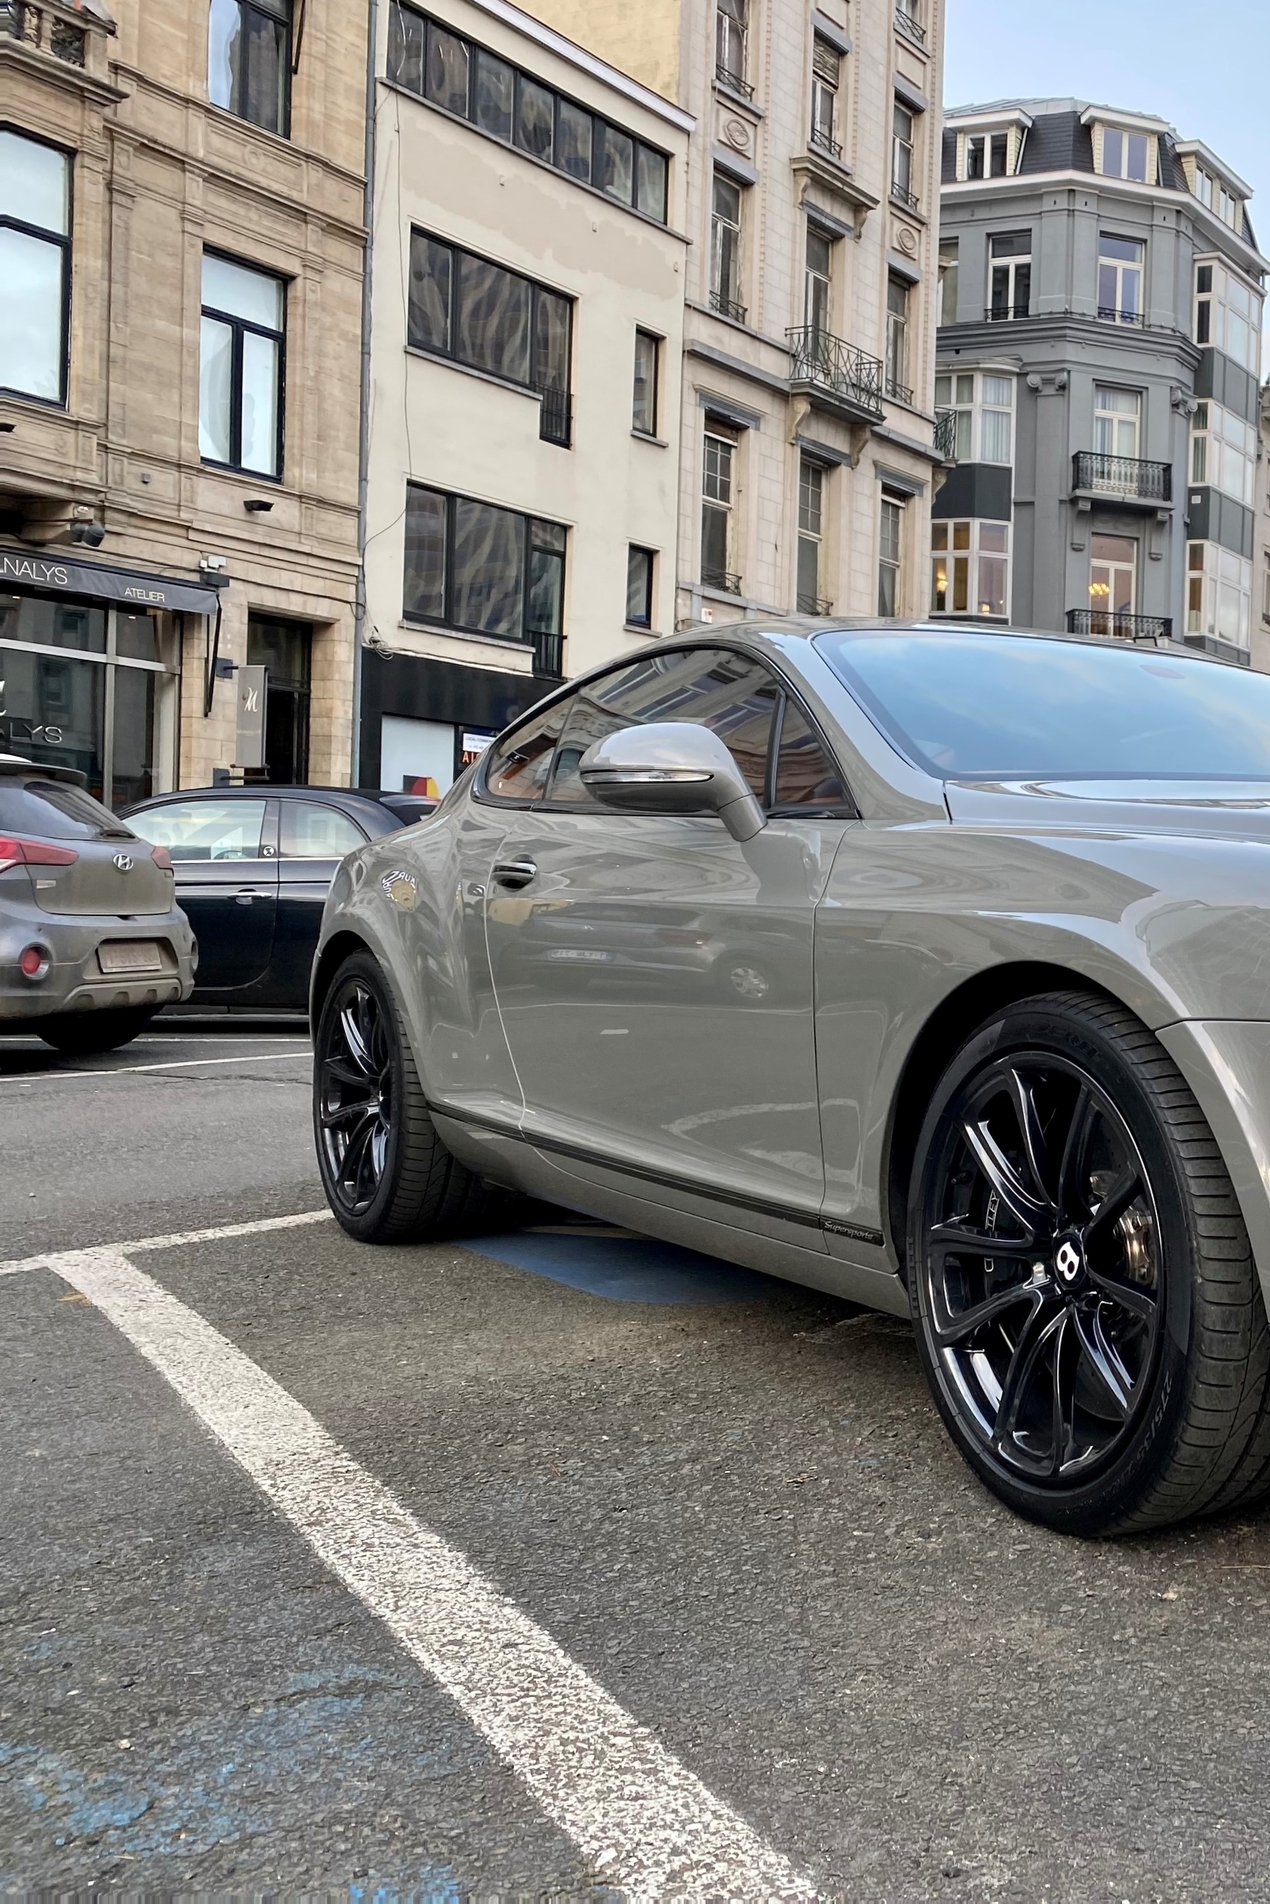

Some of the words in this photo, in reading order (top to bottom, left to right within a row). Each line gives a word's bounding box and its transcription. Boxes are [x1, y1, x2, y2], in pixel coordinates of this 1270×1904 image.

[0, 556, 68, 585] NALYS
[124, 587, 165, 602] ATELIER
[823, 1220, 874, 1240] Supersports
